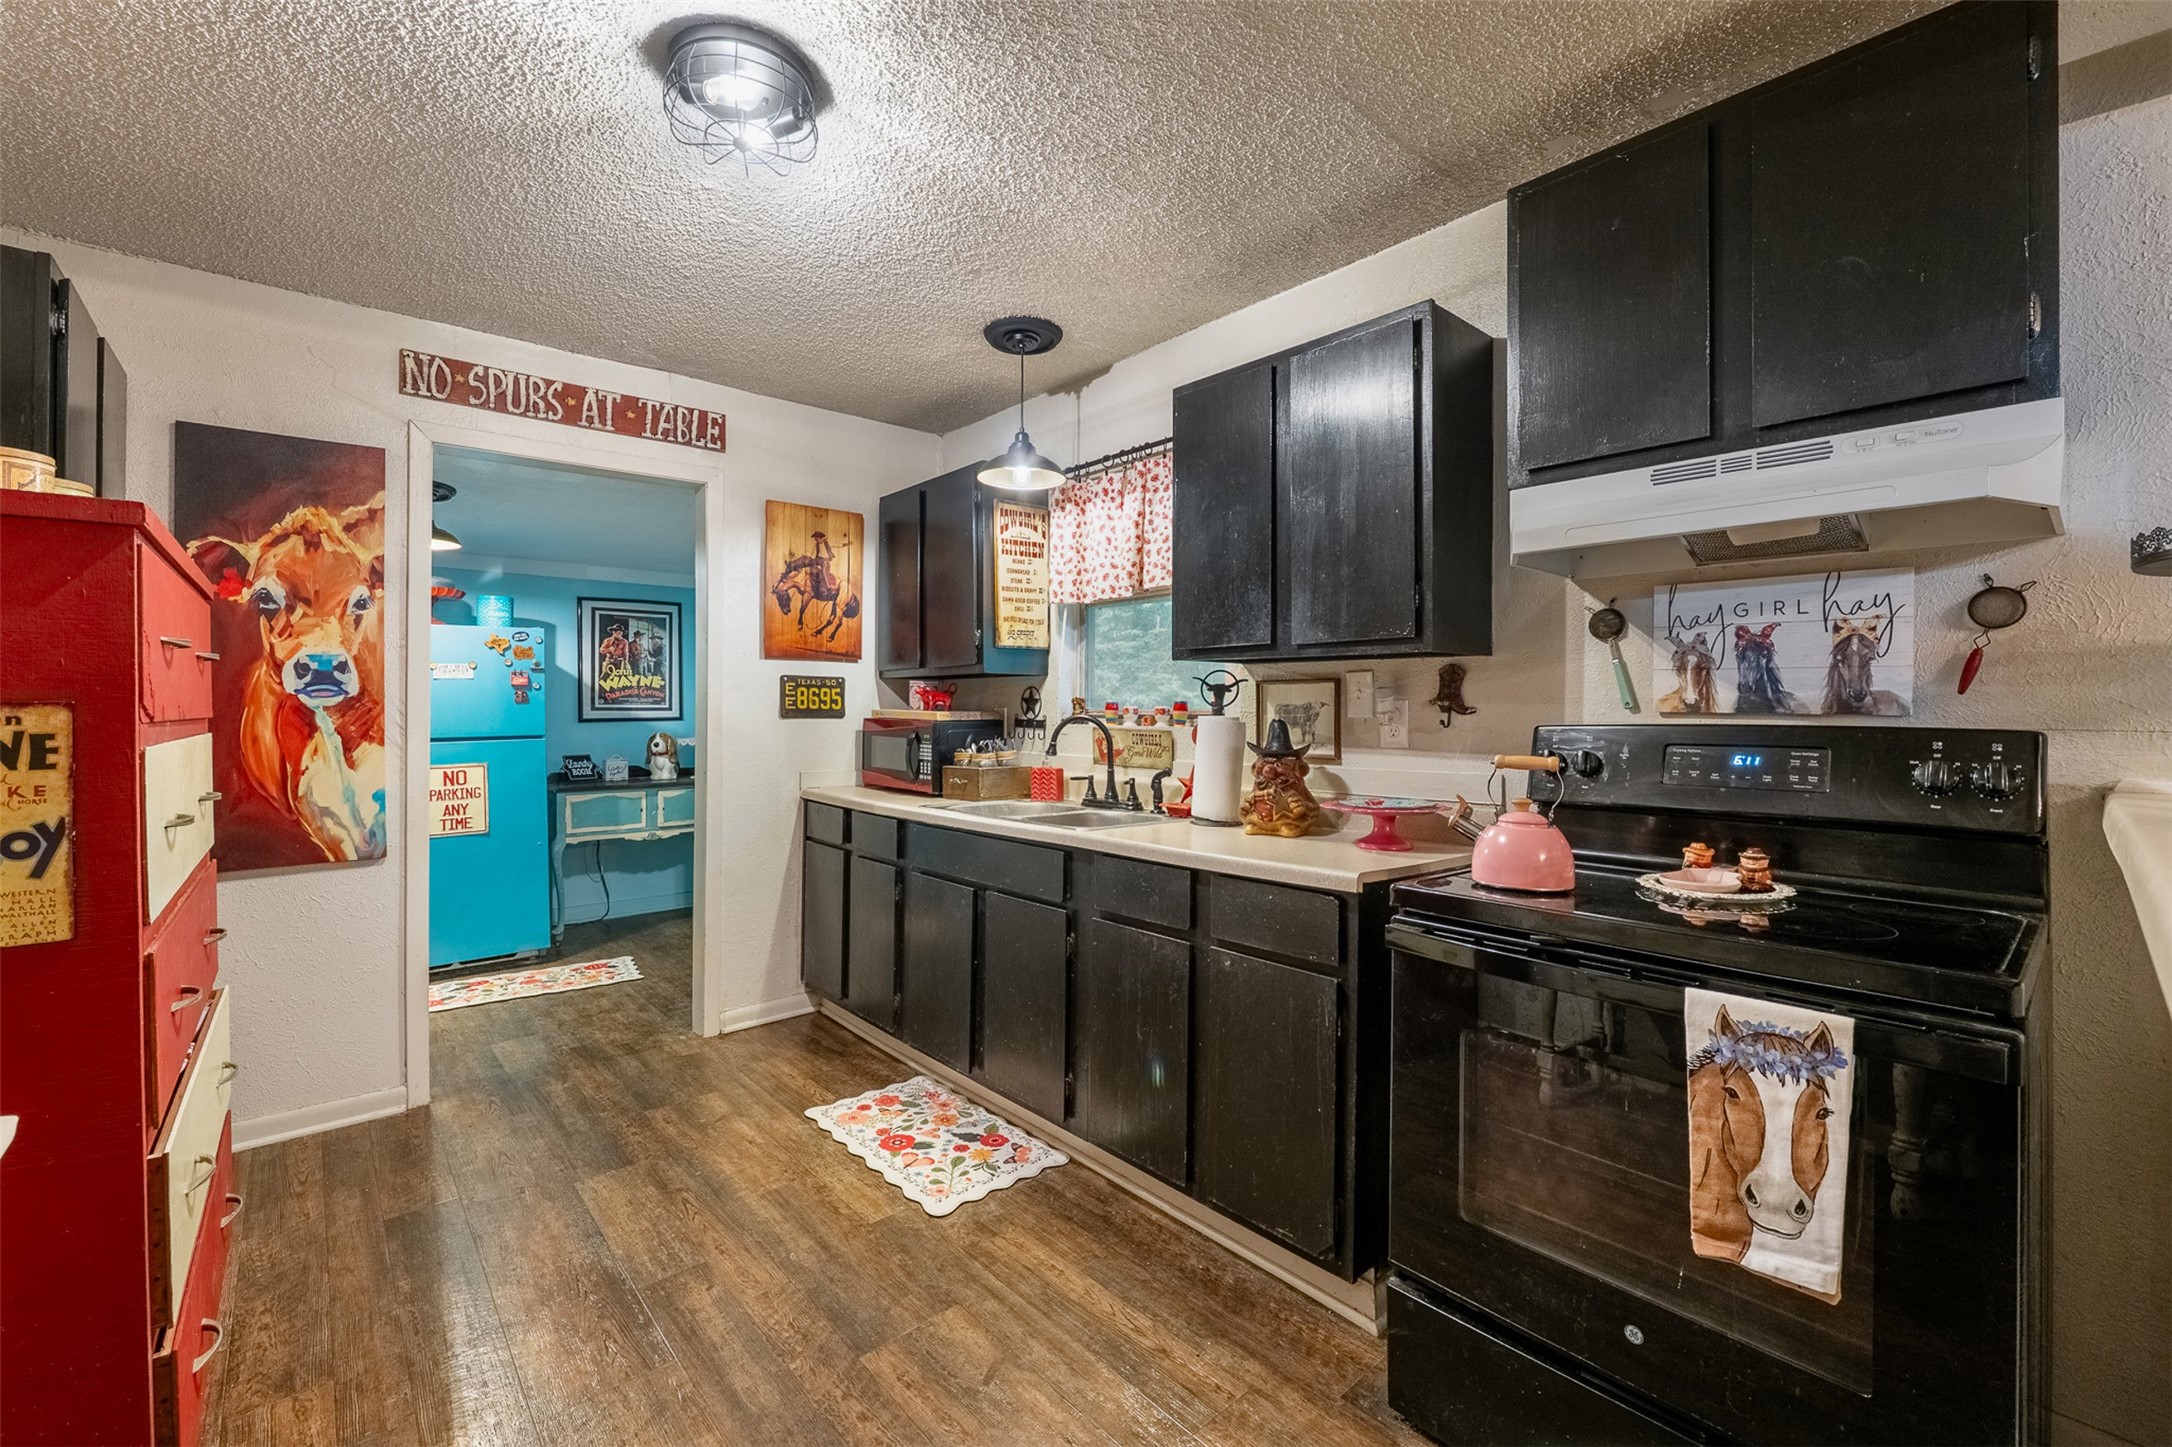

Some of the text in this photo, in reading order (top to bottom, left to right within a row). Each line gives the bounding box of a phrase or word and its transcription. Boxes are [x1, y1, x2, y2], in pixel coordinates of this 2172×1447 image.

[402, 350, 725, 450] NO SPURS AT TABLE
[1001, 538, 1044, 559] KITCHEN
[1006, 568, 1030, 576] CORNBREAD
[1667, 571, 1906, 671] hay GIRL hay
[606, 661, 633, 680] John
[599, 675, 666, 692] WAYNE
[797, 687, 842, 710] 8695
[1132, 732, 1162, 747] COWGIRLS
[443, 770, 467, 787] NO
[429, 786, 482, 802] PARKING
[442, 803, 469, 817] ANY
[439, 817, 473, 832] TIME
